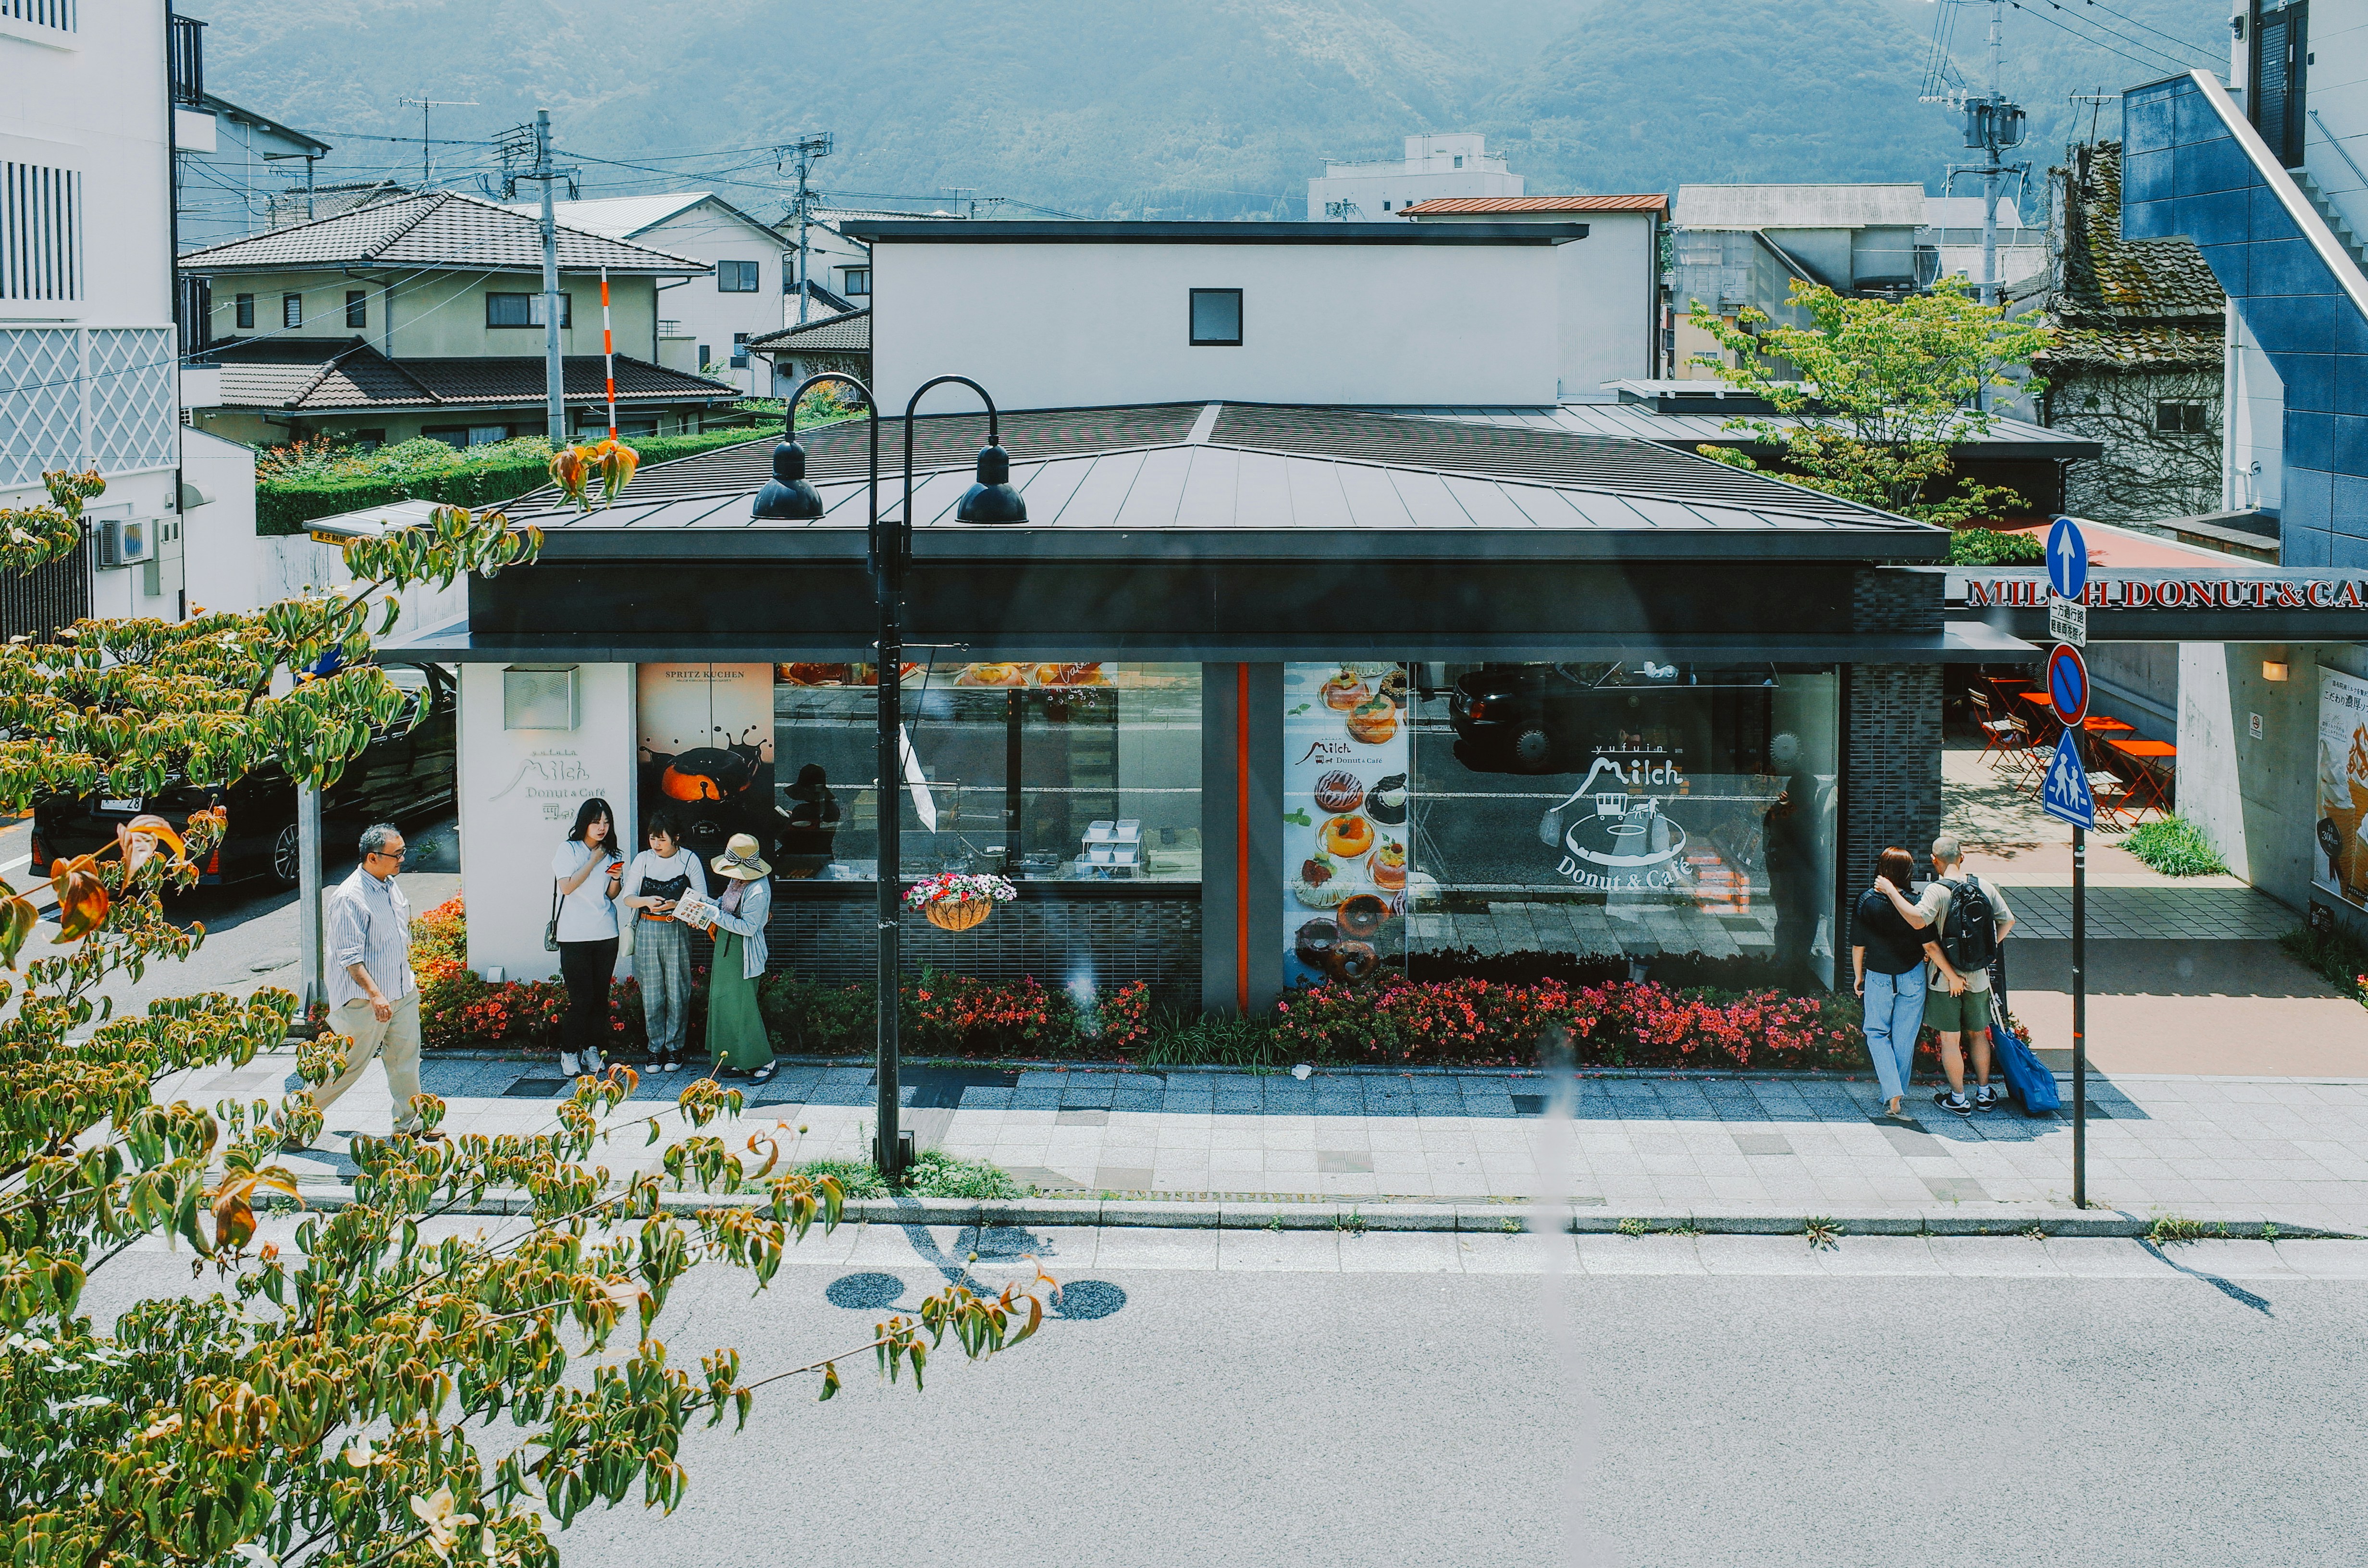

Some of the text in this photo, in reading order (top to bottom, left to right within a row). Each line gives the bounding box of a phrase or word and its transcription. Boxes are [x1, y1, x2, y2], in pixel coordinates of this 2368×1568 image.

[1969, 580, 2368, 608] MILH DONUT&CA
[2052, 603, 2084, 624] 一方通行路
[2051, 619, 2084, 644] 軽車両を除く
[1295, 742, 1351, 765] Milch
[1595, 743, 1663, 755] yufuin
[488, 759, 590, 802] Milch
[525, 787, 568, 798] Donut
[579, 787, 605, 797] Café
[1549, 757, 1684, 813] Milch
[1555, 855, 1694, 892] Donut & Café
